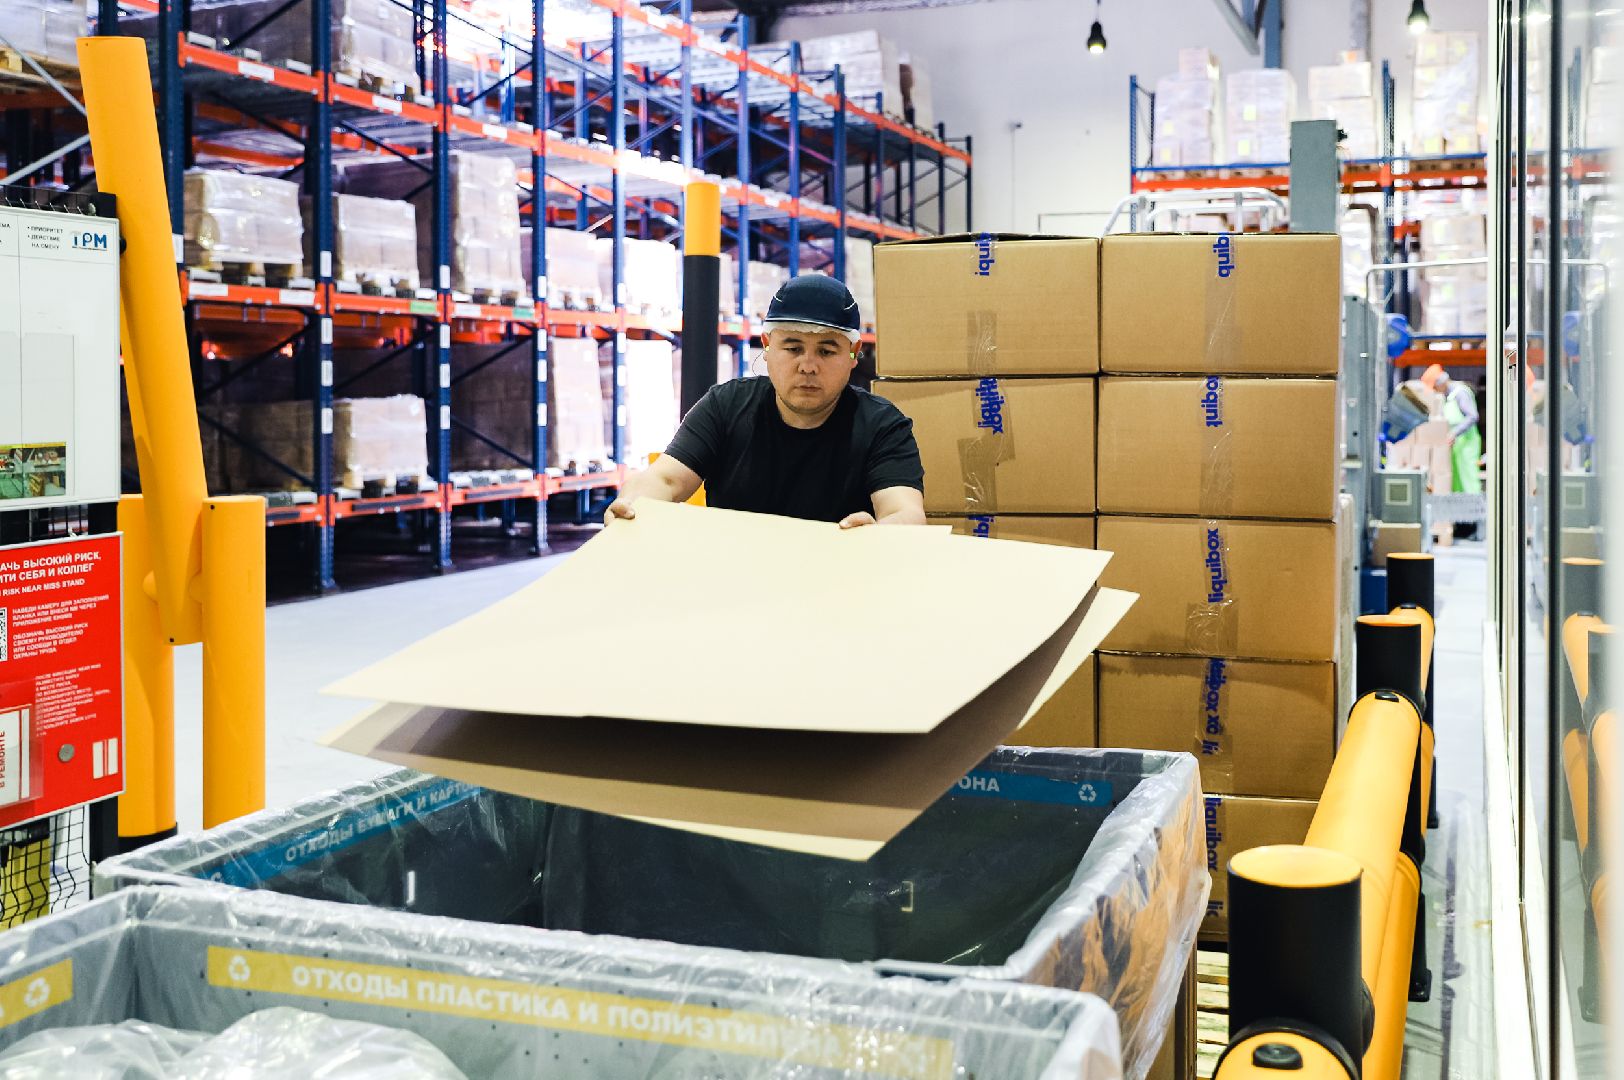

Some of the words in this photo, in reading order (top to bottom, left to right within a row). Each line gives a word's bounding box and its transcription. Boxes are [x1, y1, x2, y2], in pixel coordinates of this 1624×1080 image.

[1213, 232, 1235, 278] quib
[23, 553, 73, 569] ВЫСОКИЙ
[74, 551, 102, 562] РИСК,
[1205, 527, 1228, 603] liquibox
[19, 569, 46, 581] СЕБЯ
[48, 567, 56, 577] И
[57, 563, 95, 576] КОЛЛЕГ
[2, 588, 21, 597] RISK
[21, 584, 42, 594] NEAR
[43, 581, 61, 591] MISS
[62, 578, 86, 588] STAND
[417, 795, 427, 811] И
[291, 965, 409, 999] ОТХОДЫ
[416, 980, 571, 1022] ПЛАСТИКА
[577, 1001, 599, 1025] И
